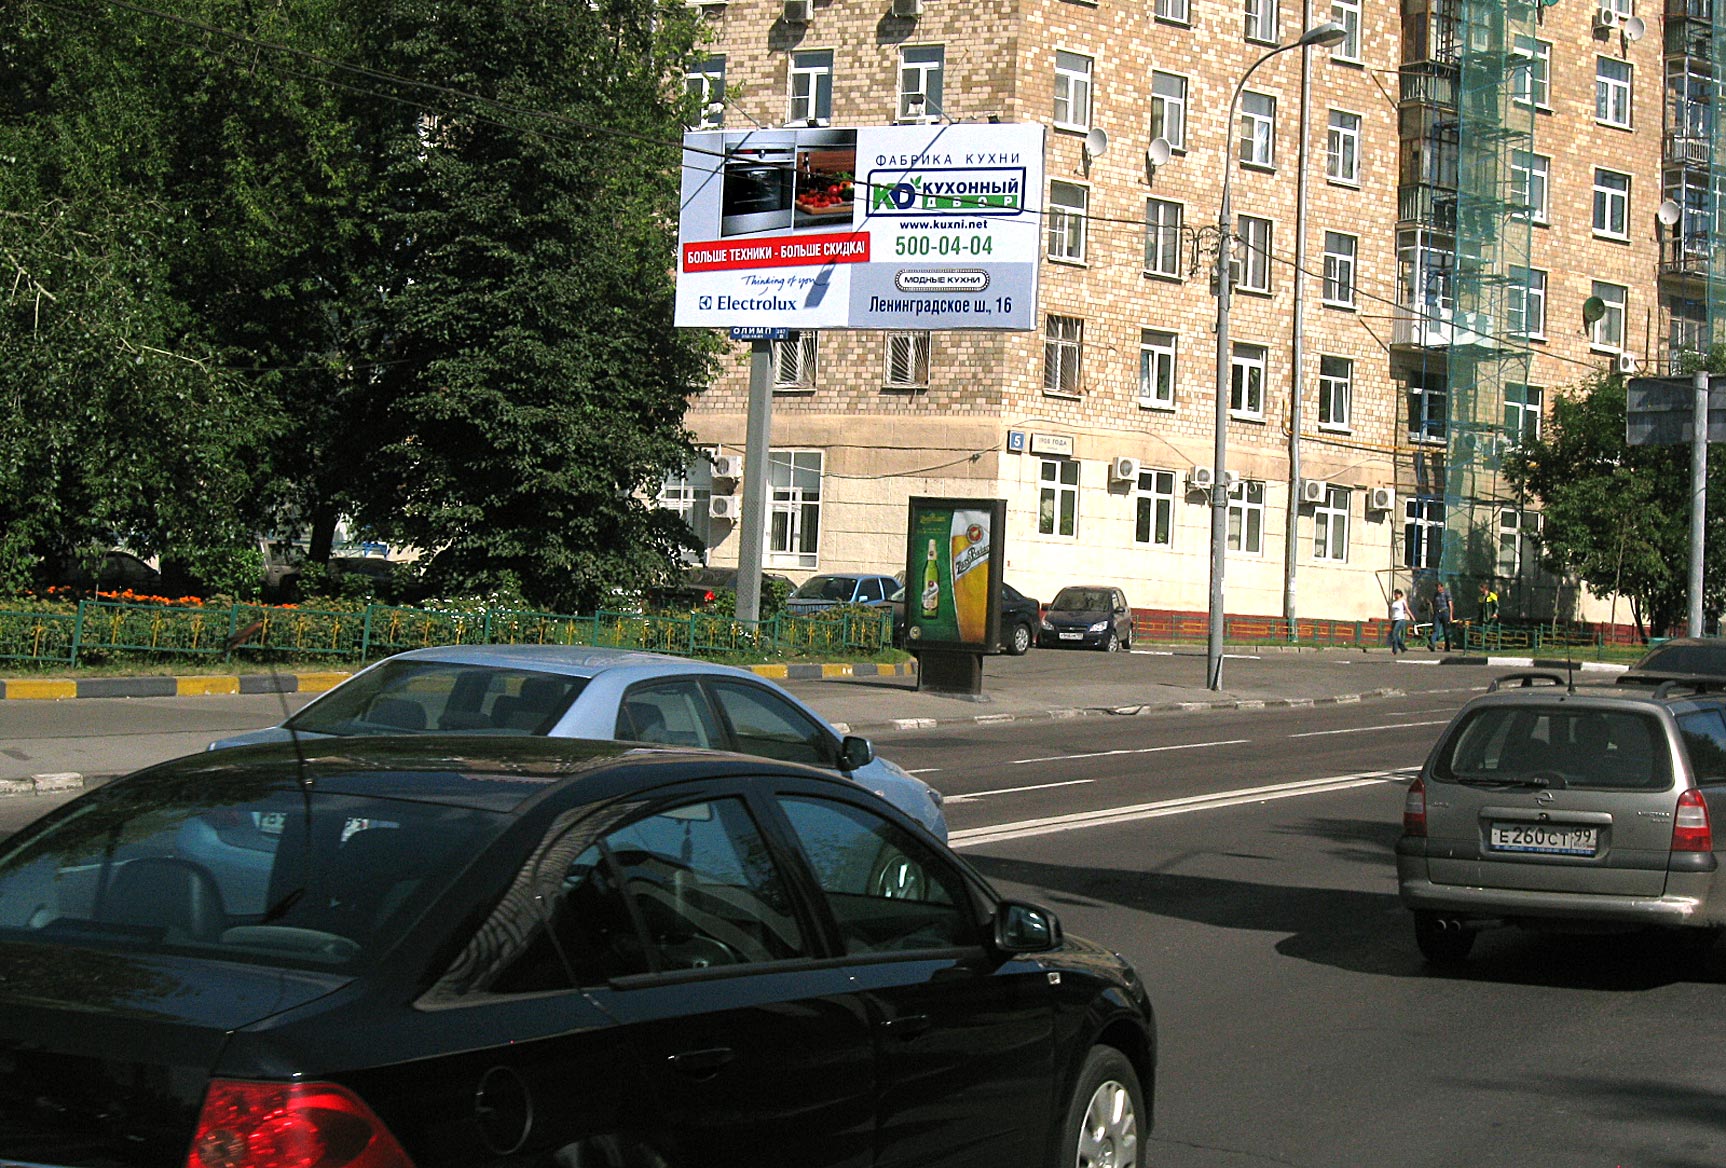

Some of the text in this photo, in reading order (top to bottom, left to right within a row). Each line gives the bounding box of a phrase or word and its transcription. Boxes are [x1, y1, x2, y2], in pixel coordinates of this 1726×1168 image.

[875, 153, 1020, 166] ФАБРИКА КУХНИ
[922, 178, 1019, 194] КУХОННЫЙ
[926, 196, 1013, 208] ДВОР
[900, 219, 988, 229] www.kuxni.net
[687, 249, 727, 264] БОЛЬШЕ
[730, 246, 772, 261] ТЕХНИКИ
[780, 243, 821, 258] БОЛЬШЕ
[823, 240, 865, 257] СКИДКА!
[895, 235, 993, 256] 500-04-04
[741, 275, 816, 291] Thinking of you
[904, 276, 981, 284] МОДНЫЕ КУХНИ
[717, 295, 797, 311] Electrolux
[869, 296, 970, 316] Ленинградское
[996, 297, 1012, 313] 16
[1013, 435, 1021, 446] 5
[1574, 828, 1592, 843] 99
